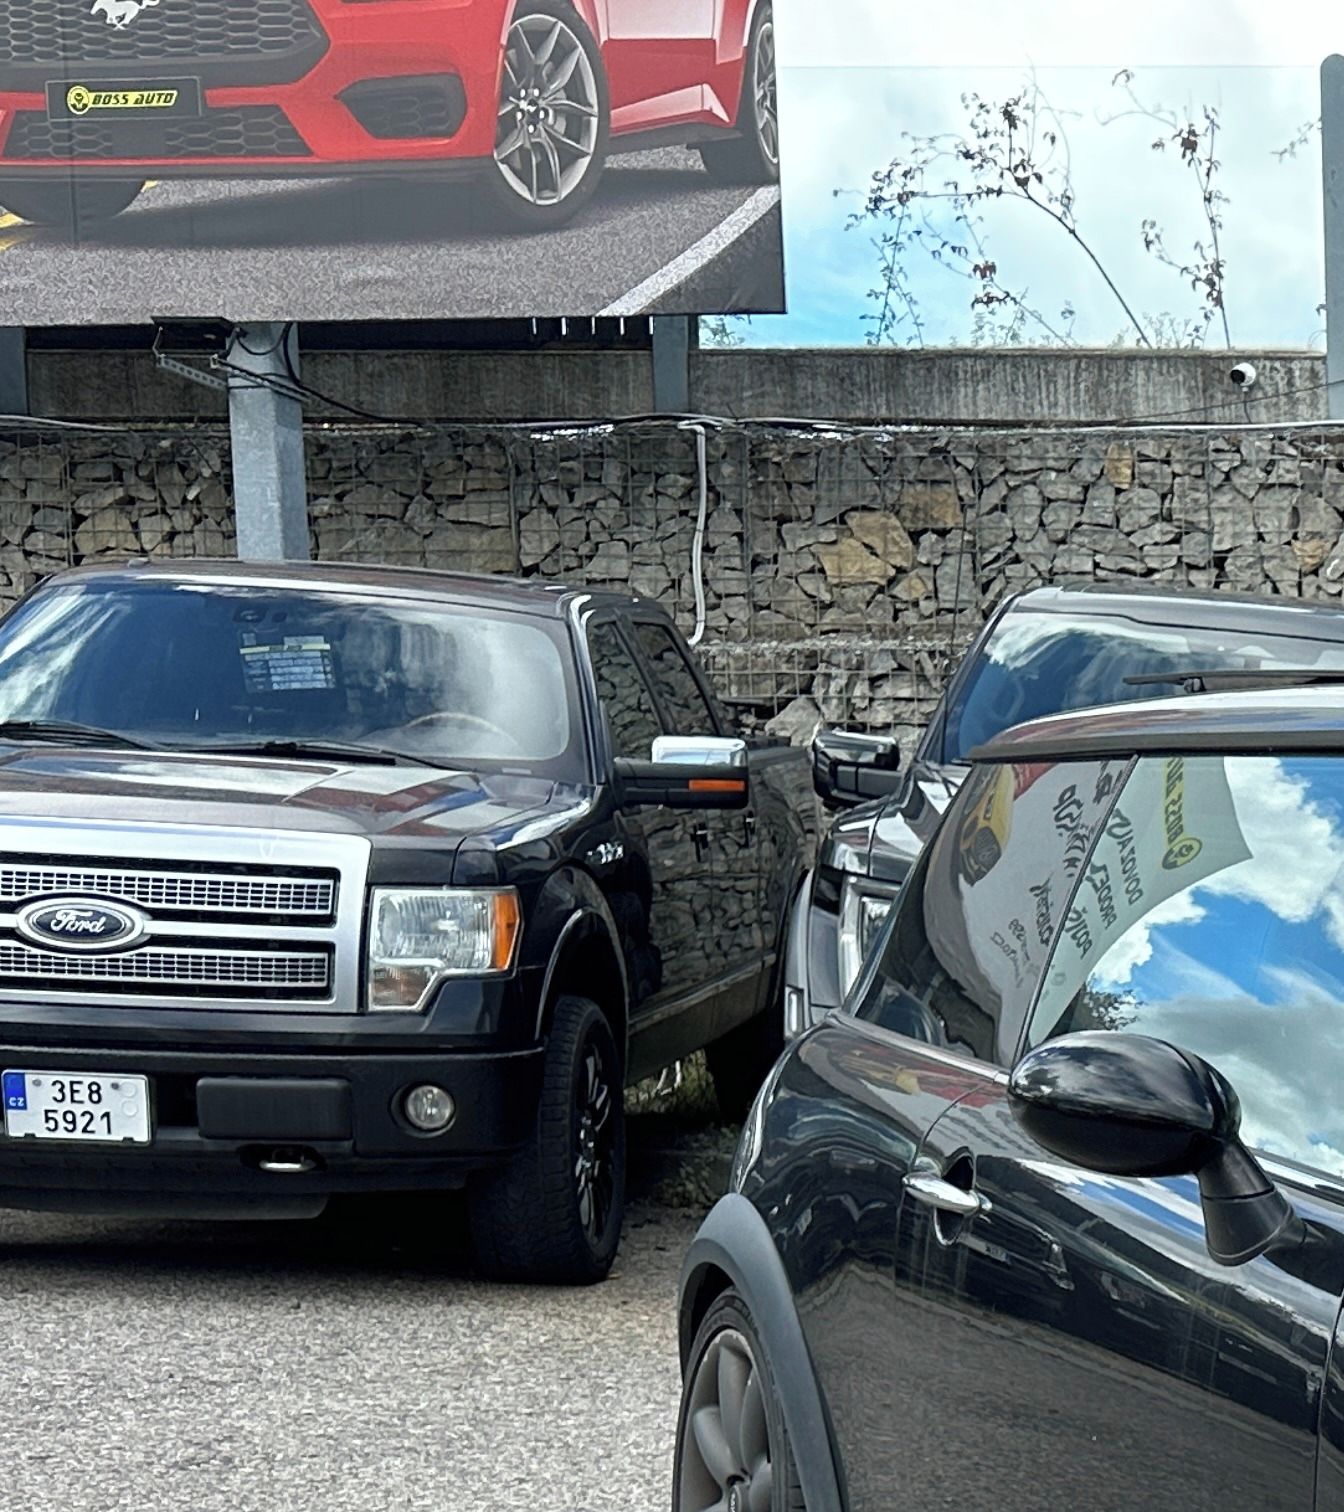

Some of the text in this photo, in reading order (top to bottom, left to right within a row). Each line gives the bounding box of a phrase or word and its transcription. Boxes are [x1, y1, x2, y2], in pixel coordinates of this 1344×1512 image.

[91, 91, 174, 106] BOSS AUTO
[50, 909, 106, 933] Ford
[9, 1097, 24, 1107] CZ
[51, 1080, 102, 1105] 3E8
[44, 1110, 112, 1135] 5921
